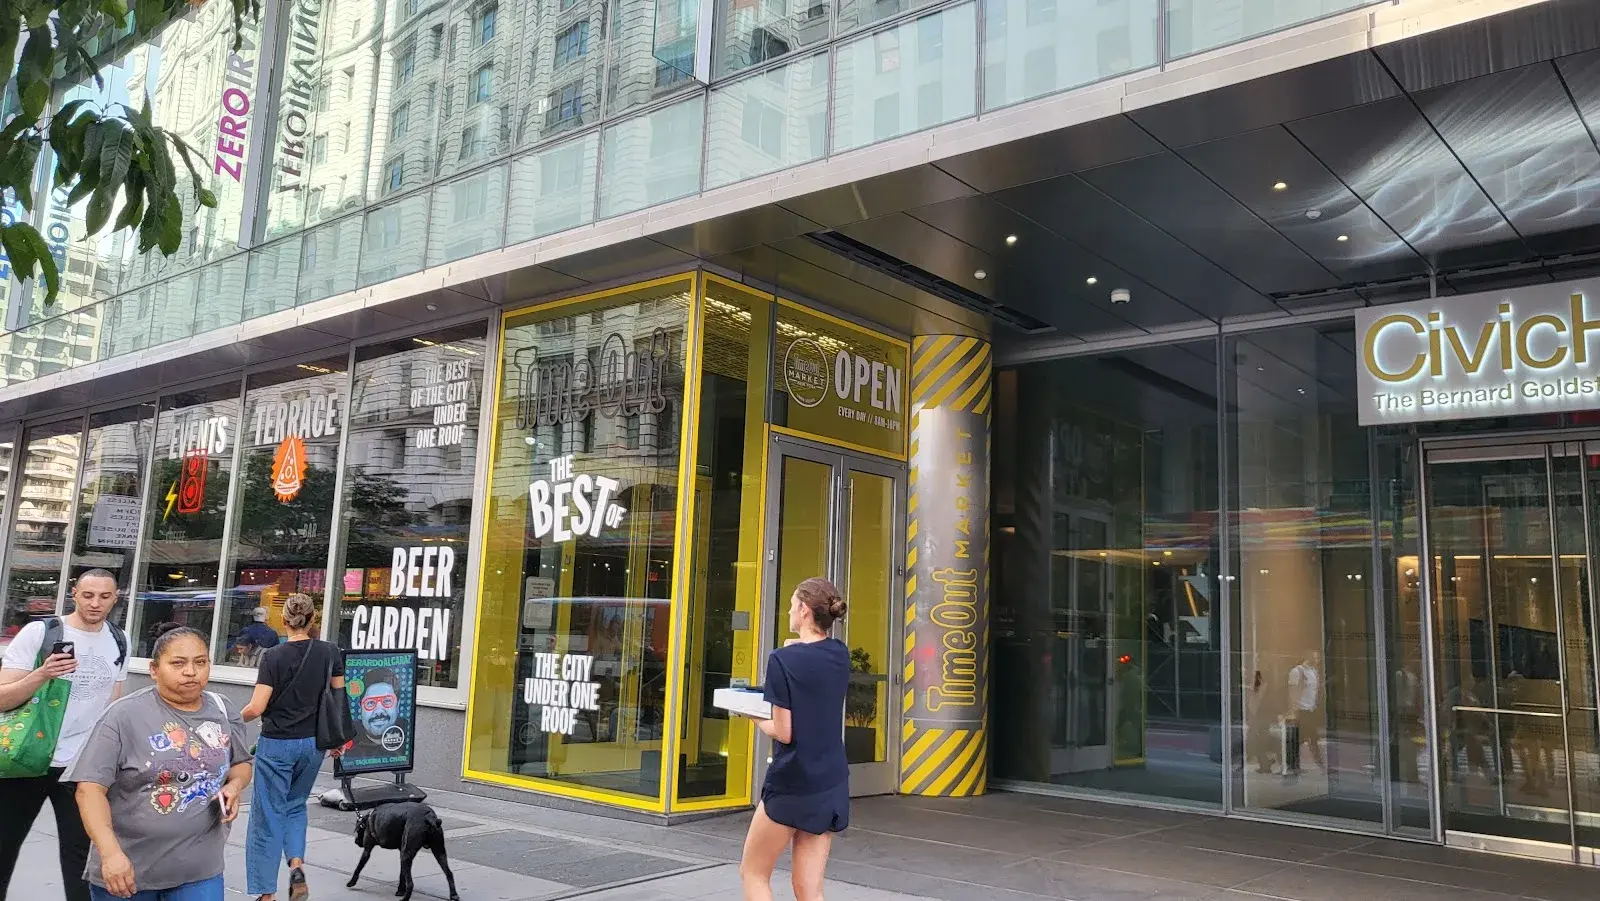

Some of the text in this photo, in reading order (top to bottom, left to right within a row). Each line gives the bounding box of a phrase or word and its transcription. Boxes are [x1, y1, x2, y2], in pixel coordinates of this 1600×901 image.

[425, 359, 471, 384] THE BEST
[788, 370, 825, 386] MARKET
[835, 350, 900, 414] OPEN
[411, 380, 469, 408] OF THE CITY
[1373, 393, 1412, 410] The
[1420, 383, 1512, 407] Bernard
[254, 392, 338, 446] TERRACE
[433, 402, 468, 425] UNDER
[838, 405, 855, 419] EVERY
[856, 410, 867, 422] DAY
[169, 415, 229, 460] EVENTS
[416, 423, 466, 449] ONE ROOF
[549, 454, 574, 482] THE
[529, 473, 627, 543] BEST OF
[955, 429, 972, 559] MARKET
[389, 546, 455, 597] BEER
[350, 604, 450, 661] GARDEN
[346, 657, 383, 667] GERARDO
[535, 652, 593, 682] THE CITY
[524, 677, 601, 711] UNDER ONE
[541, 706, 579, 735] ROOF
